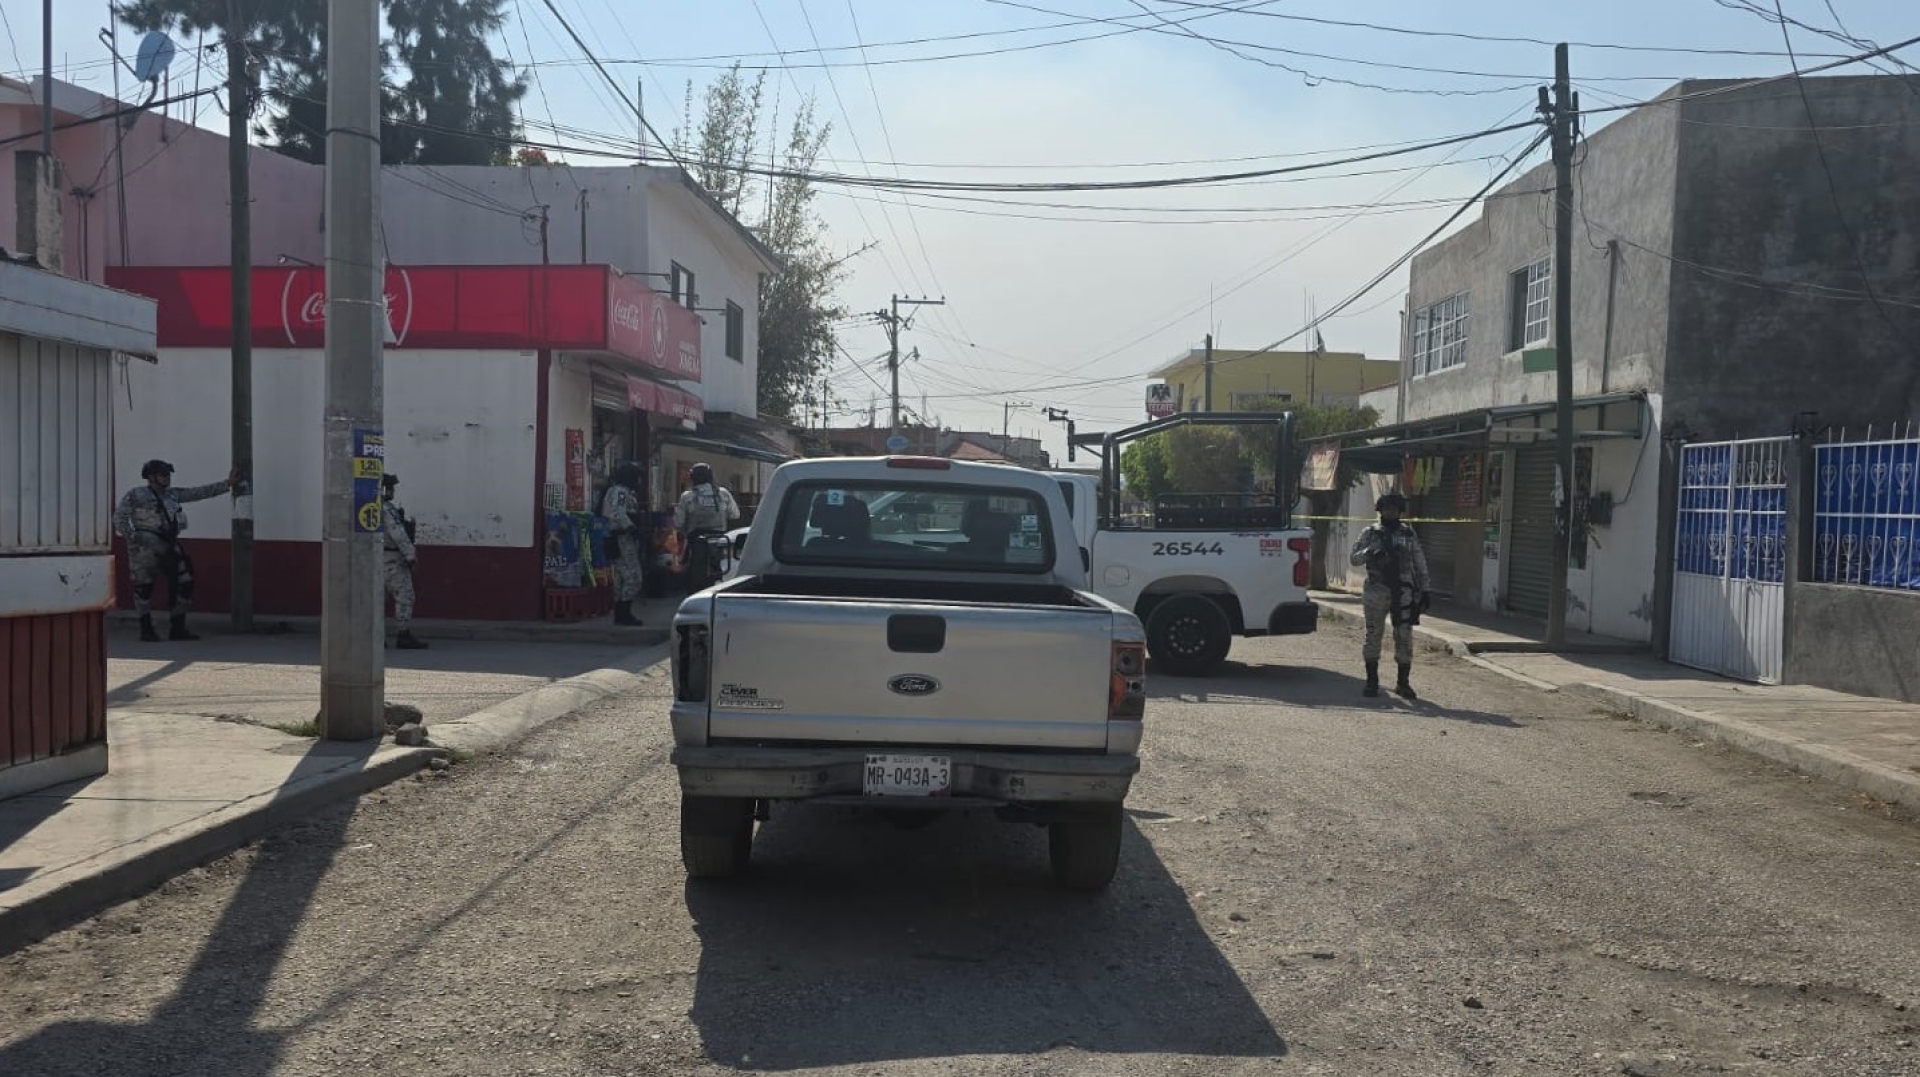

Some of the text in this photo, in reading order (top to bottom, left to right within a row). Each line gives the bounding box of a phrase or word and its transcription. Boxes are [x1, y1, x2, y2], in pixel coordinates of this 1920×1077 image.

[1152, 542, 1225, 556] 26544
[899, 679, 928, 691] Ford
[866, 766, 948, 787] MR-043A-3
